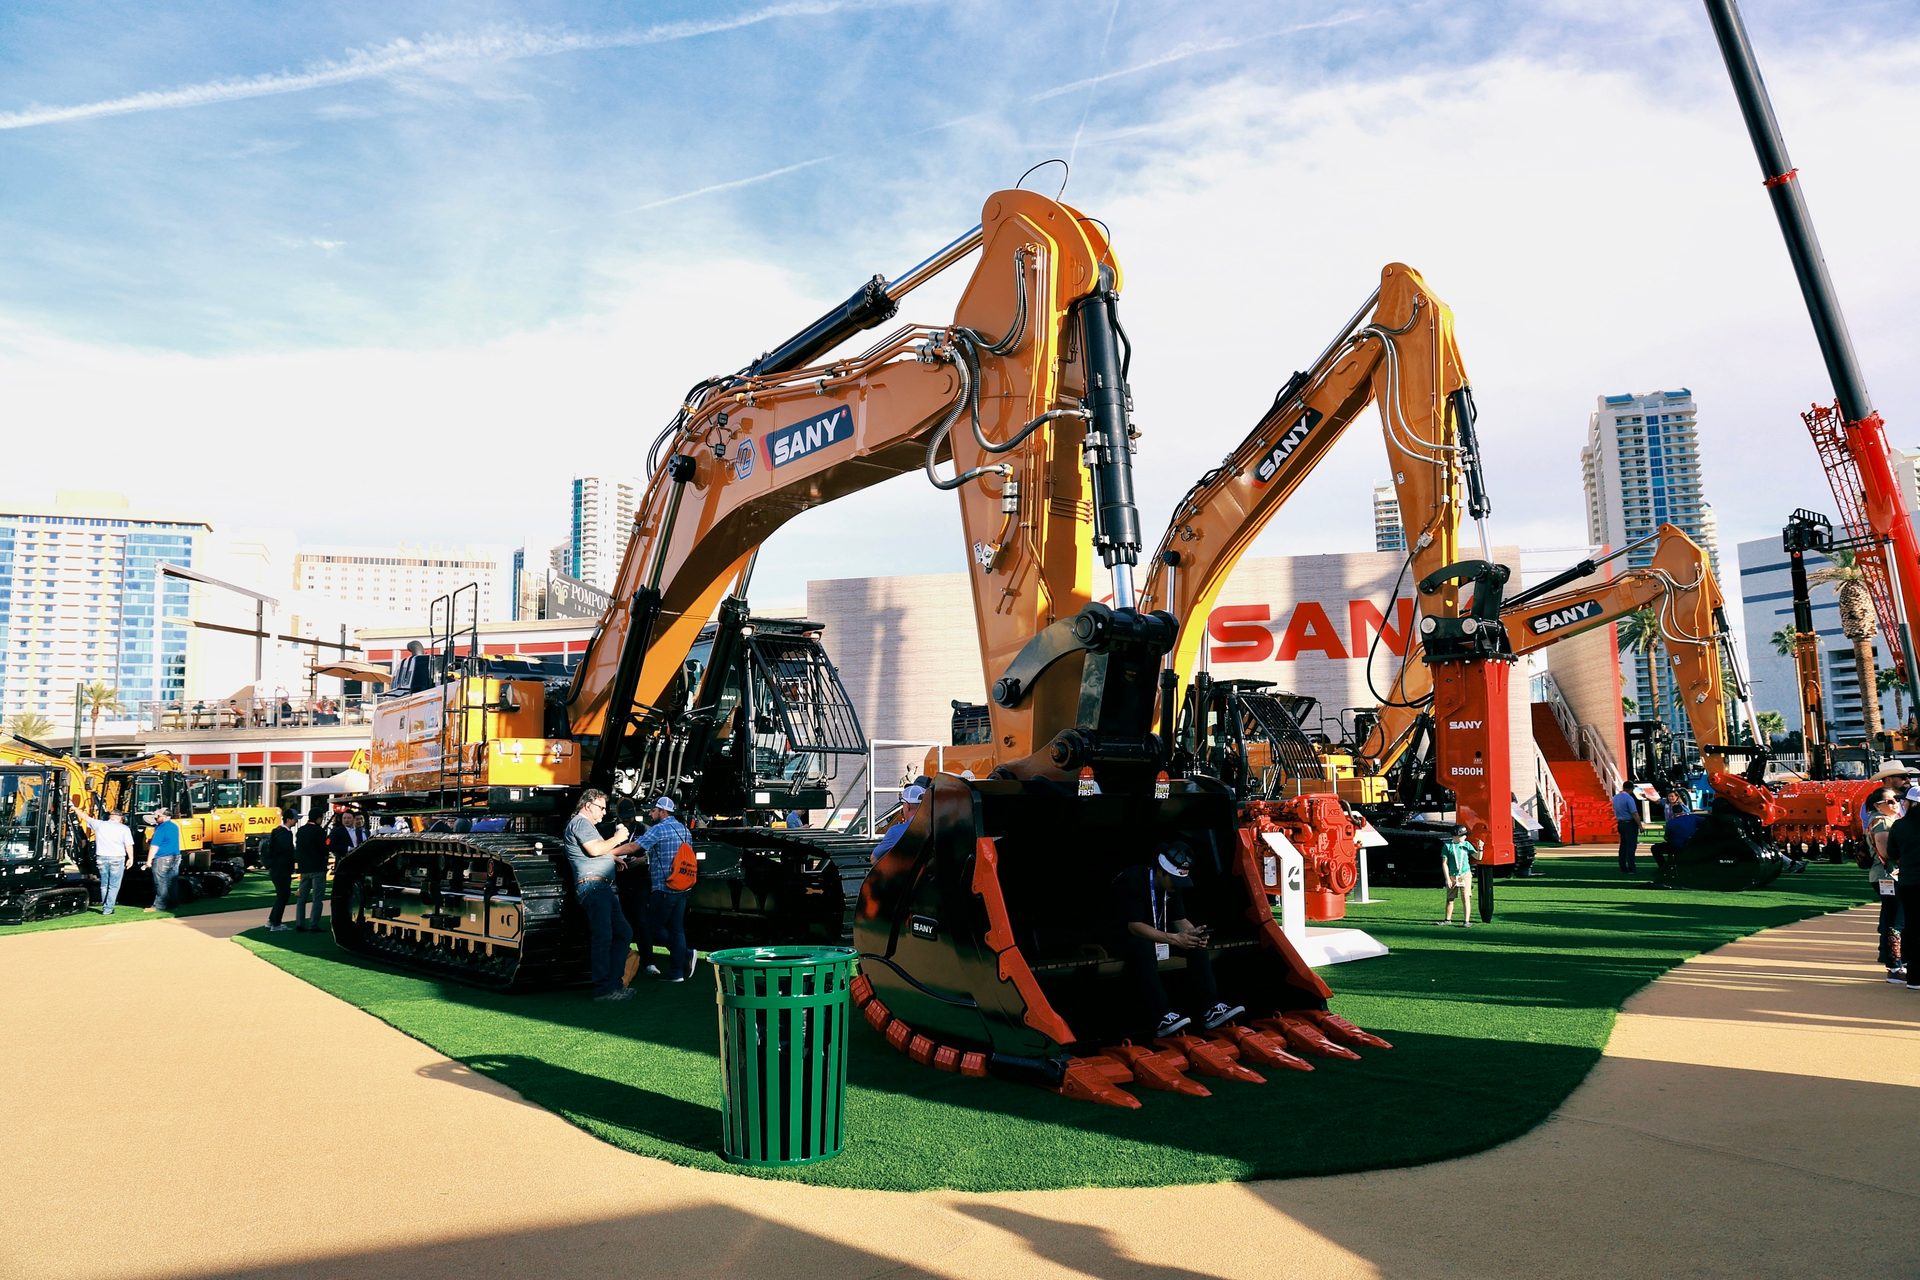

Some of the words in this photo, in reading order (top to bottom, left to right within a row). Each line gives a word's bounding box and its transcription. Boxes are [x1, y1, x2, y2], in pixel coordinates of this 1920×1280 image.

[774, 412, 840, 465] SANY
[1259, 415, 1309, 481] SANY
[1534, 602, 1591, 634] SANY
[1208, 597, 1474, 663] SAN
[1449, 720, 1483, 730] SANY
[1451, 767, 1484, 776] B500H
[249, 816, 276, 825] SANY
[219, 822, 243, 834] SANY
[913, 922, 934, 934] SANY
